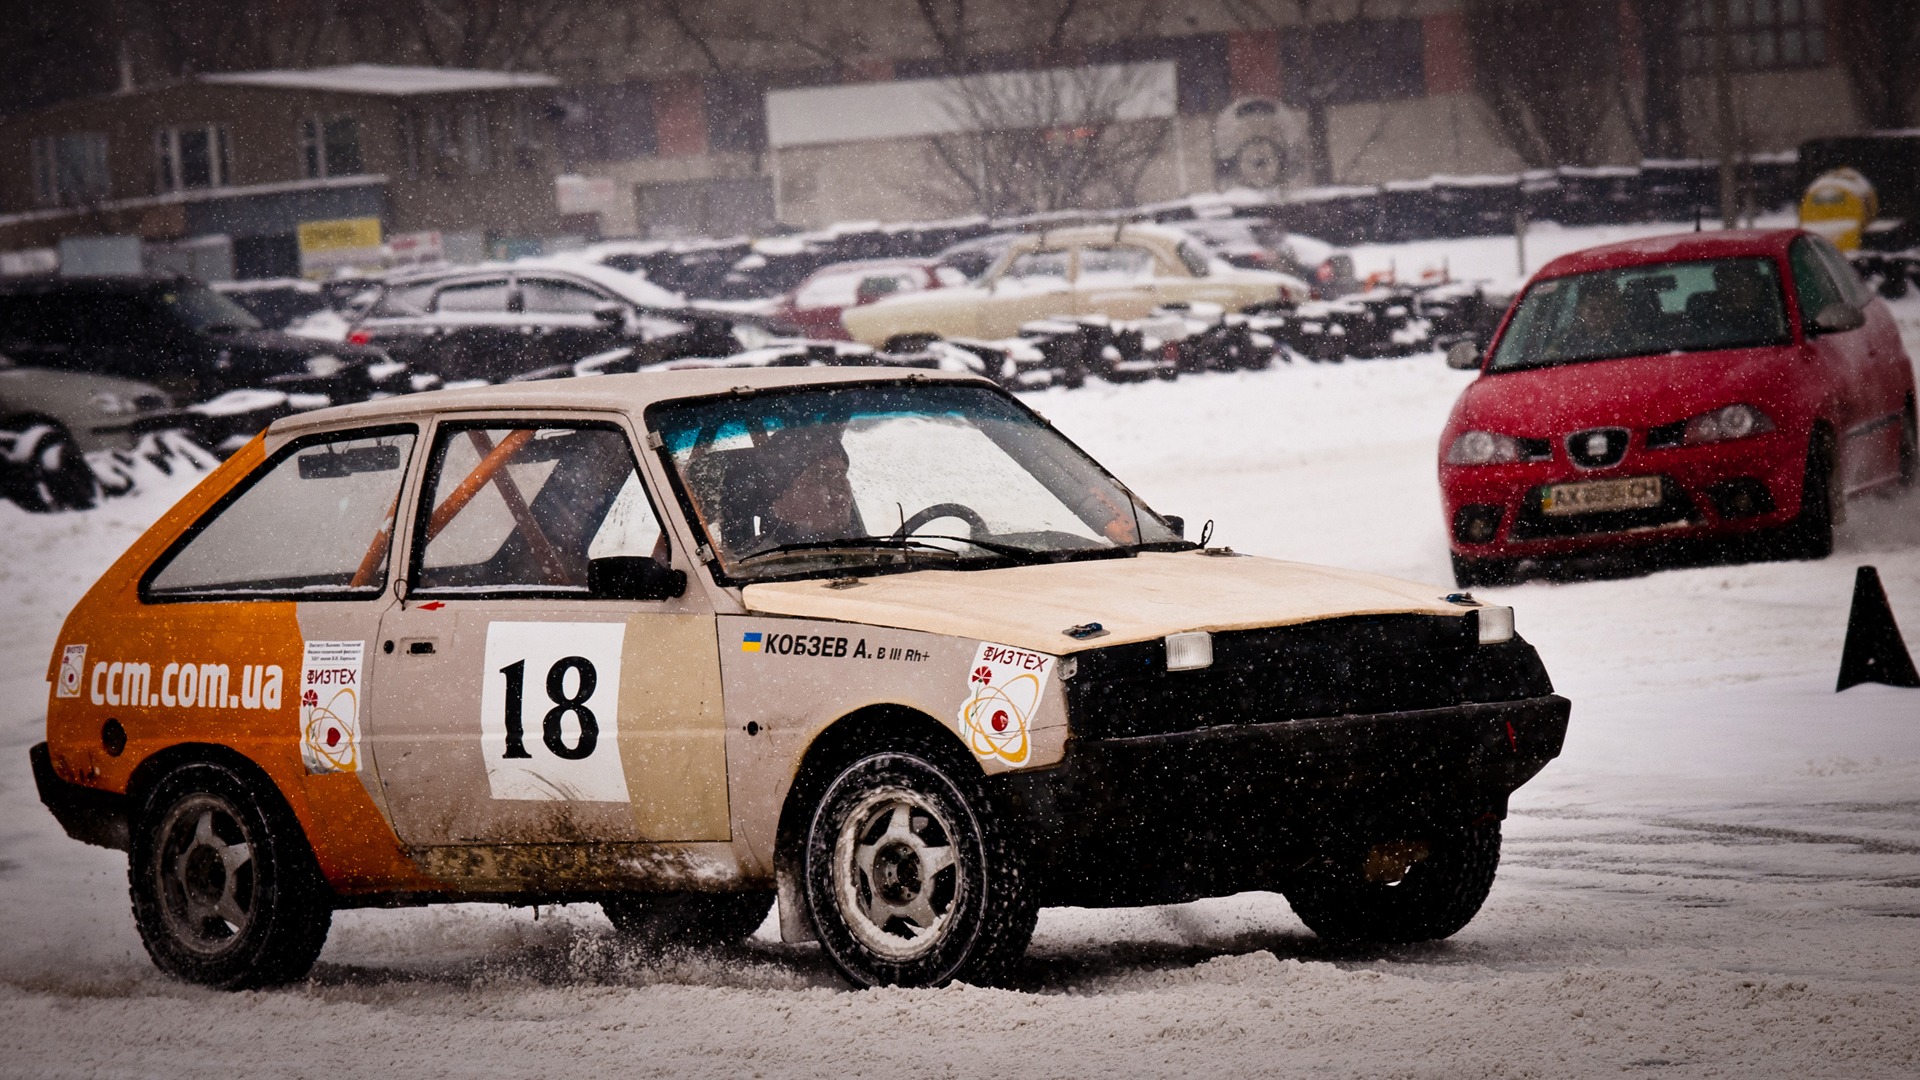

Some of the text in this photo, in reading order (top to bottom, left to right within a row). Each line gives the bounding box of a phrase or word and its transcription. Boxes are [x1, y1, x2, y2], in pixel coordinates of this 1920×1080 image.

[764, 633, 849, 658] КОБЗЕВ
[852, 638, 872, 659] А.
[904, 648, 931, 662] Rh+
[982, 646, 1049, 673] ФИЗТЕХ
[90, 661, 283, 710] ccm.com.ua
[306, 668, 357, 685] ФИЗТЕХ
[499, 656, 600, 760] 18
